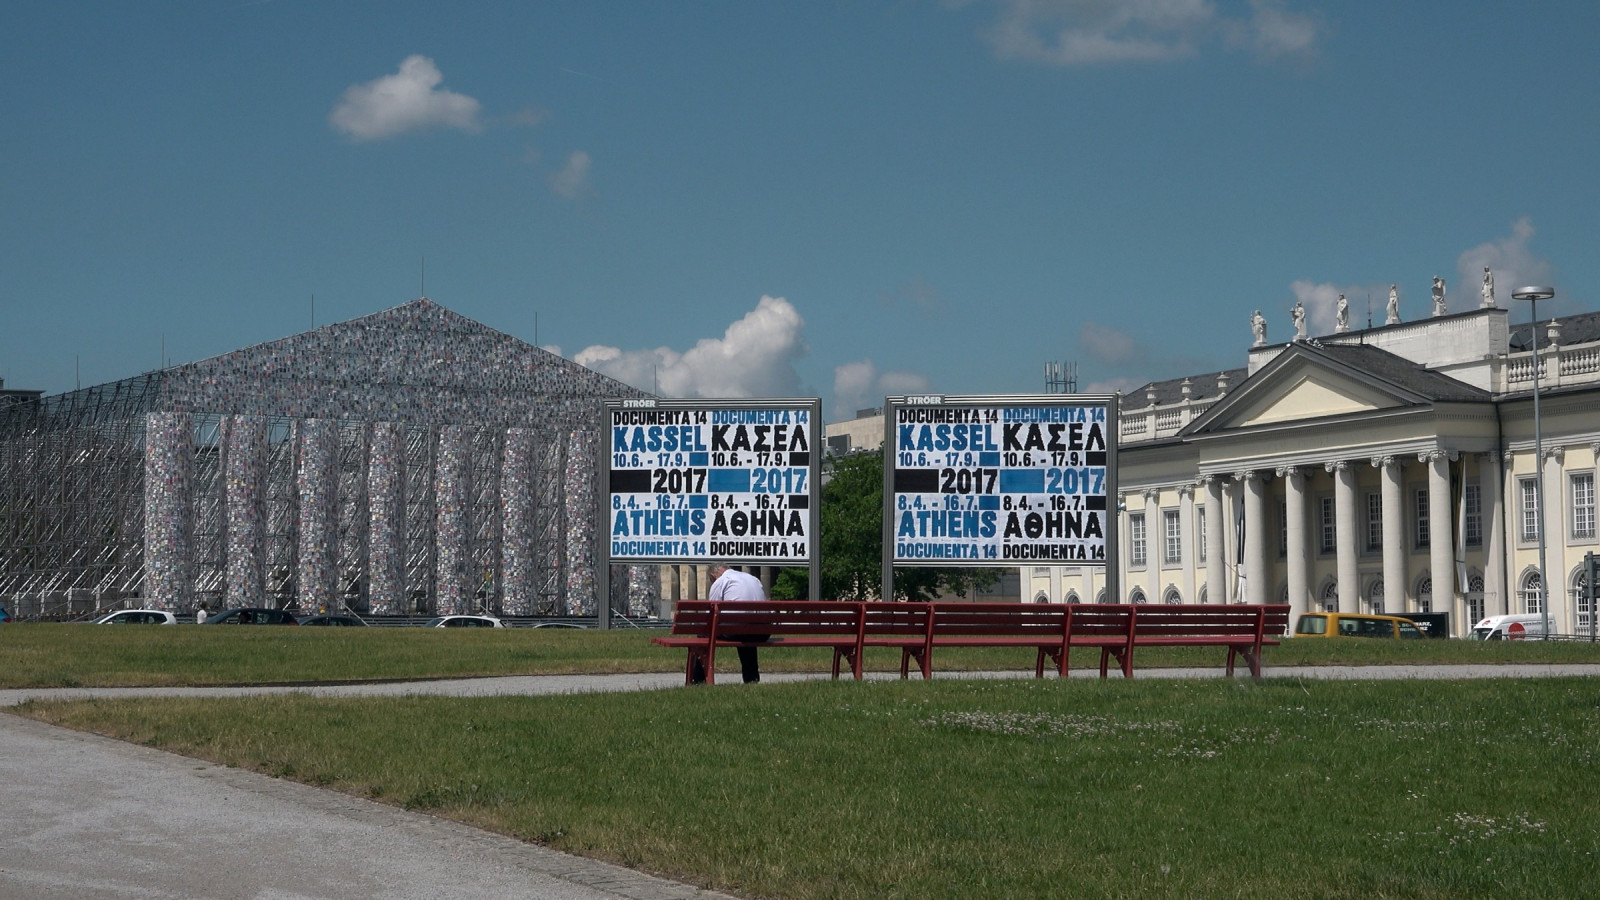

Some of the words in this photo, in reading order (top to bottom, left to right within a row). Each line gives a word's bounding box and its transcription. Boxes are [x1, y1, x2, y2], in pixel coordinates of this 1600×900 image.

[907, 396, 941, 404] STRÖER
[614, 411, 690, 425] DOCUMENTA
[694, 411, 707, 424] 14
[712, 410, 792, 424] DOCUMENTA
[794, 411, 807, 424] 14
[900, 409, 980, 423] DOCUMENTA
[984, 409, 998, 423] 14
[1004, 408, 1087, 423] DOCUMENTA
[1090, 408, 1104, 422] 14
[614, 426, 706, 452] KASSEL
[900, 424, 998, 452] KASSEL
[613, 453, 643, 467] 10.6.
[658, 453, 686, 466] 17.9.
[712, 453, 742, 466] 10.6.
[757, 453, 786, 466] 17.9.
[899, 452, 930, 466] 10.6.
[946, 452, 976, 466] 17.9.
[1003, 452, 1035, 466] 10.6.
[1051, 452, 1083, 466] 17.9.
[653, 469, 706, 493] 2017
[752, 468, 806, 493] 2017
[941, 469, 998, 494] 2017
[1047, 468, 1104, 494] 2017
[613, 495, 639, 509] 8.4.
[656, 495, 688, 509] 16.7.
[711, 495, 738, 509] 8.4.
[755, 495, 787, 509] 16.7.
[898, 496, 926, 510] 8.4.
[944, 496, 978, 510] 16.7.
[1003, 496, 1032, 510] 8.4.
[1050, 496, 1084, 510] 16.7.
[613, 510, 705, 536] ATHENS
[898, 511, 996, 537] ATHENS
[612, 541, 689, 555] DOCUMENTA
[693, 542, 706, 555] 14
[710, 542, 788, 556] DOCUMENTA
[792, 542, 805, 556] 14
[897, 543, 978, 558] DOCUMENTA
[983, 544, 997, 558] 14
[1003, 544, 1086, 559] DOCUMENTA
[1090, 545, 1104, 559] 14
